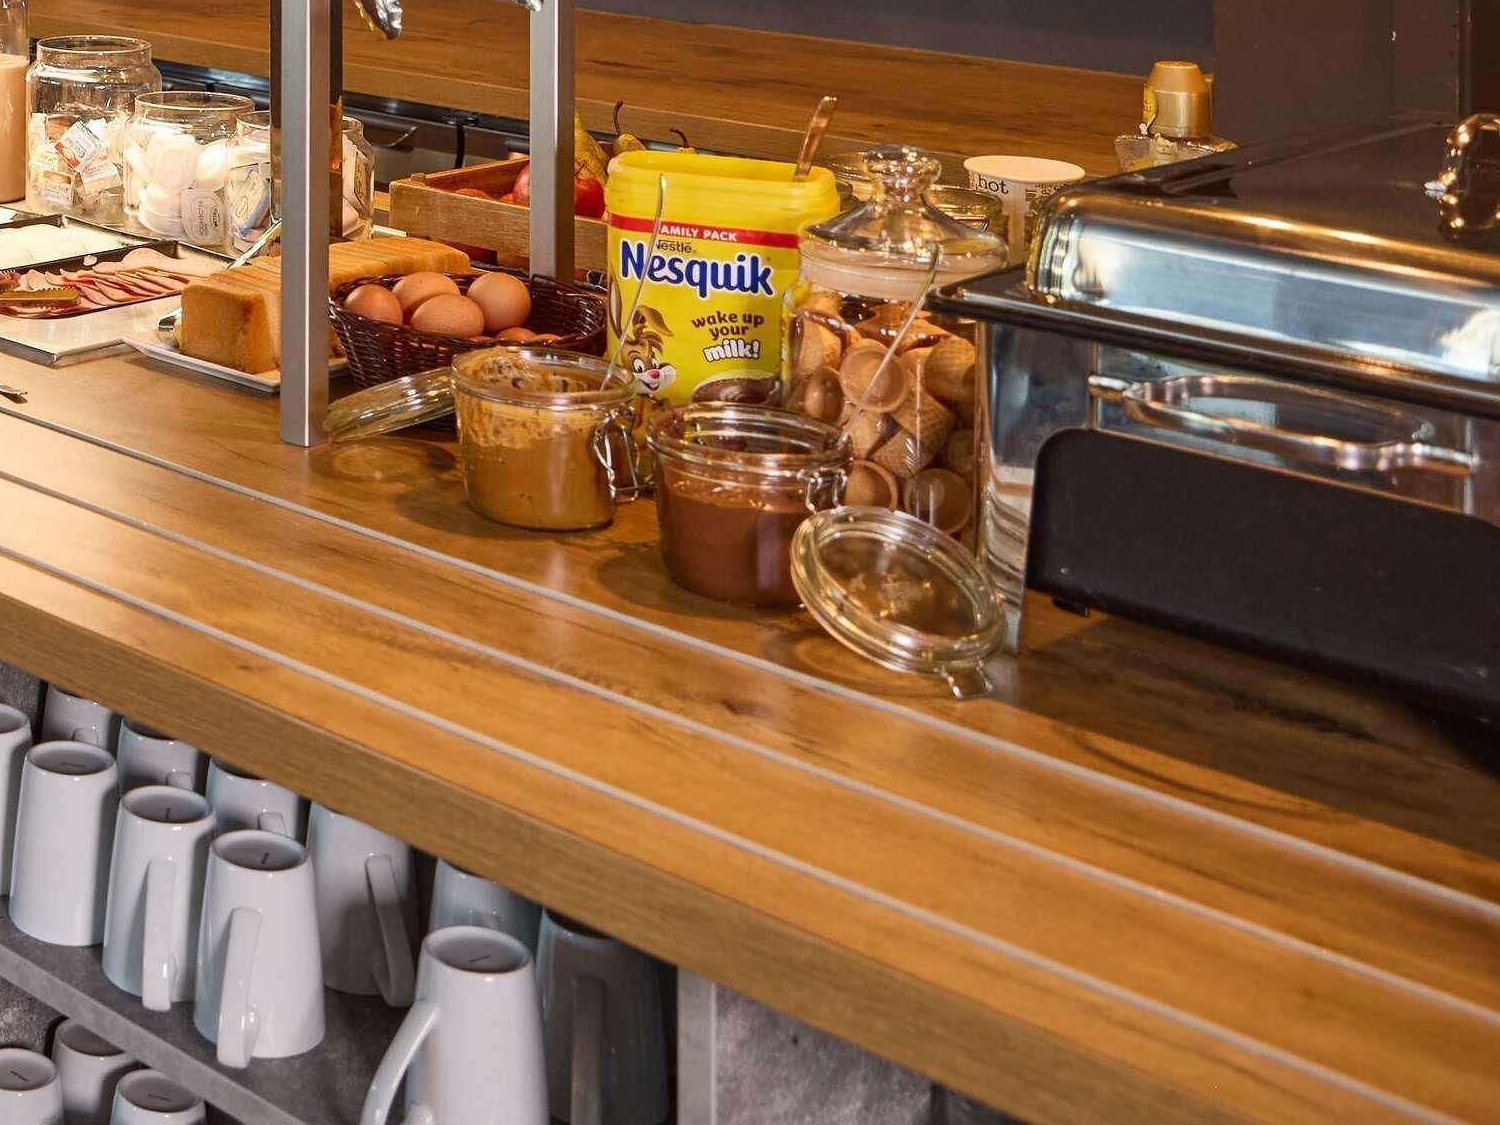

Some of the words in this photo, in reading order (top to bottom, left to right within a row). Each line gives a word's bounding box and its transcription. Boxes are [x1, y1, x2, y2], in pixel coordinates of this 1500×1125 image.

[978, 174, 1009, 195] hot
[660, 225, 699, 238] AMILY
[703, 229, 738, 242] PACK
[620, 240, 774, 299] Nesquik
[691, 310, 738, 328] wake
[742, 313, 764, 328] up
[708, 325, 749, 341] your
[703, 338, 760, 362] milk!
